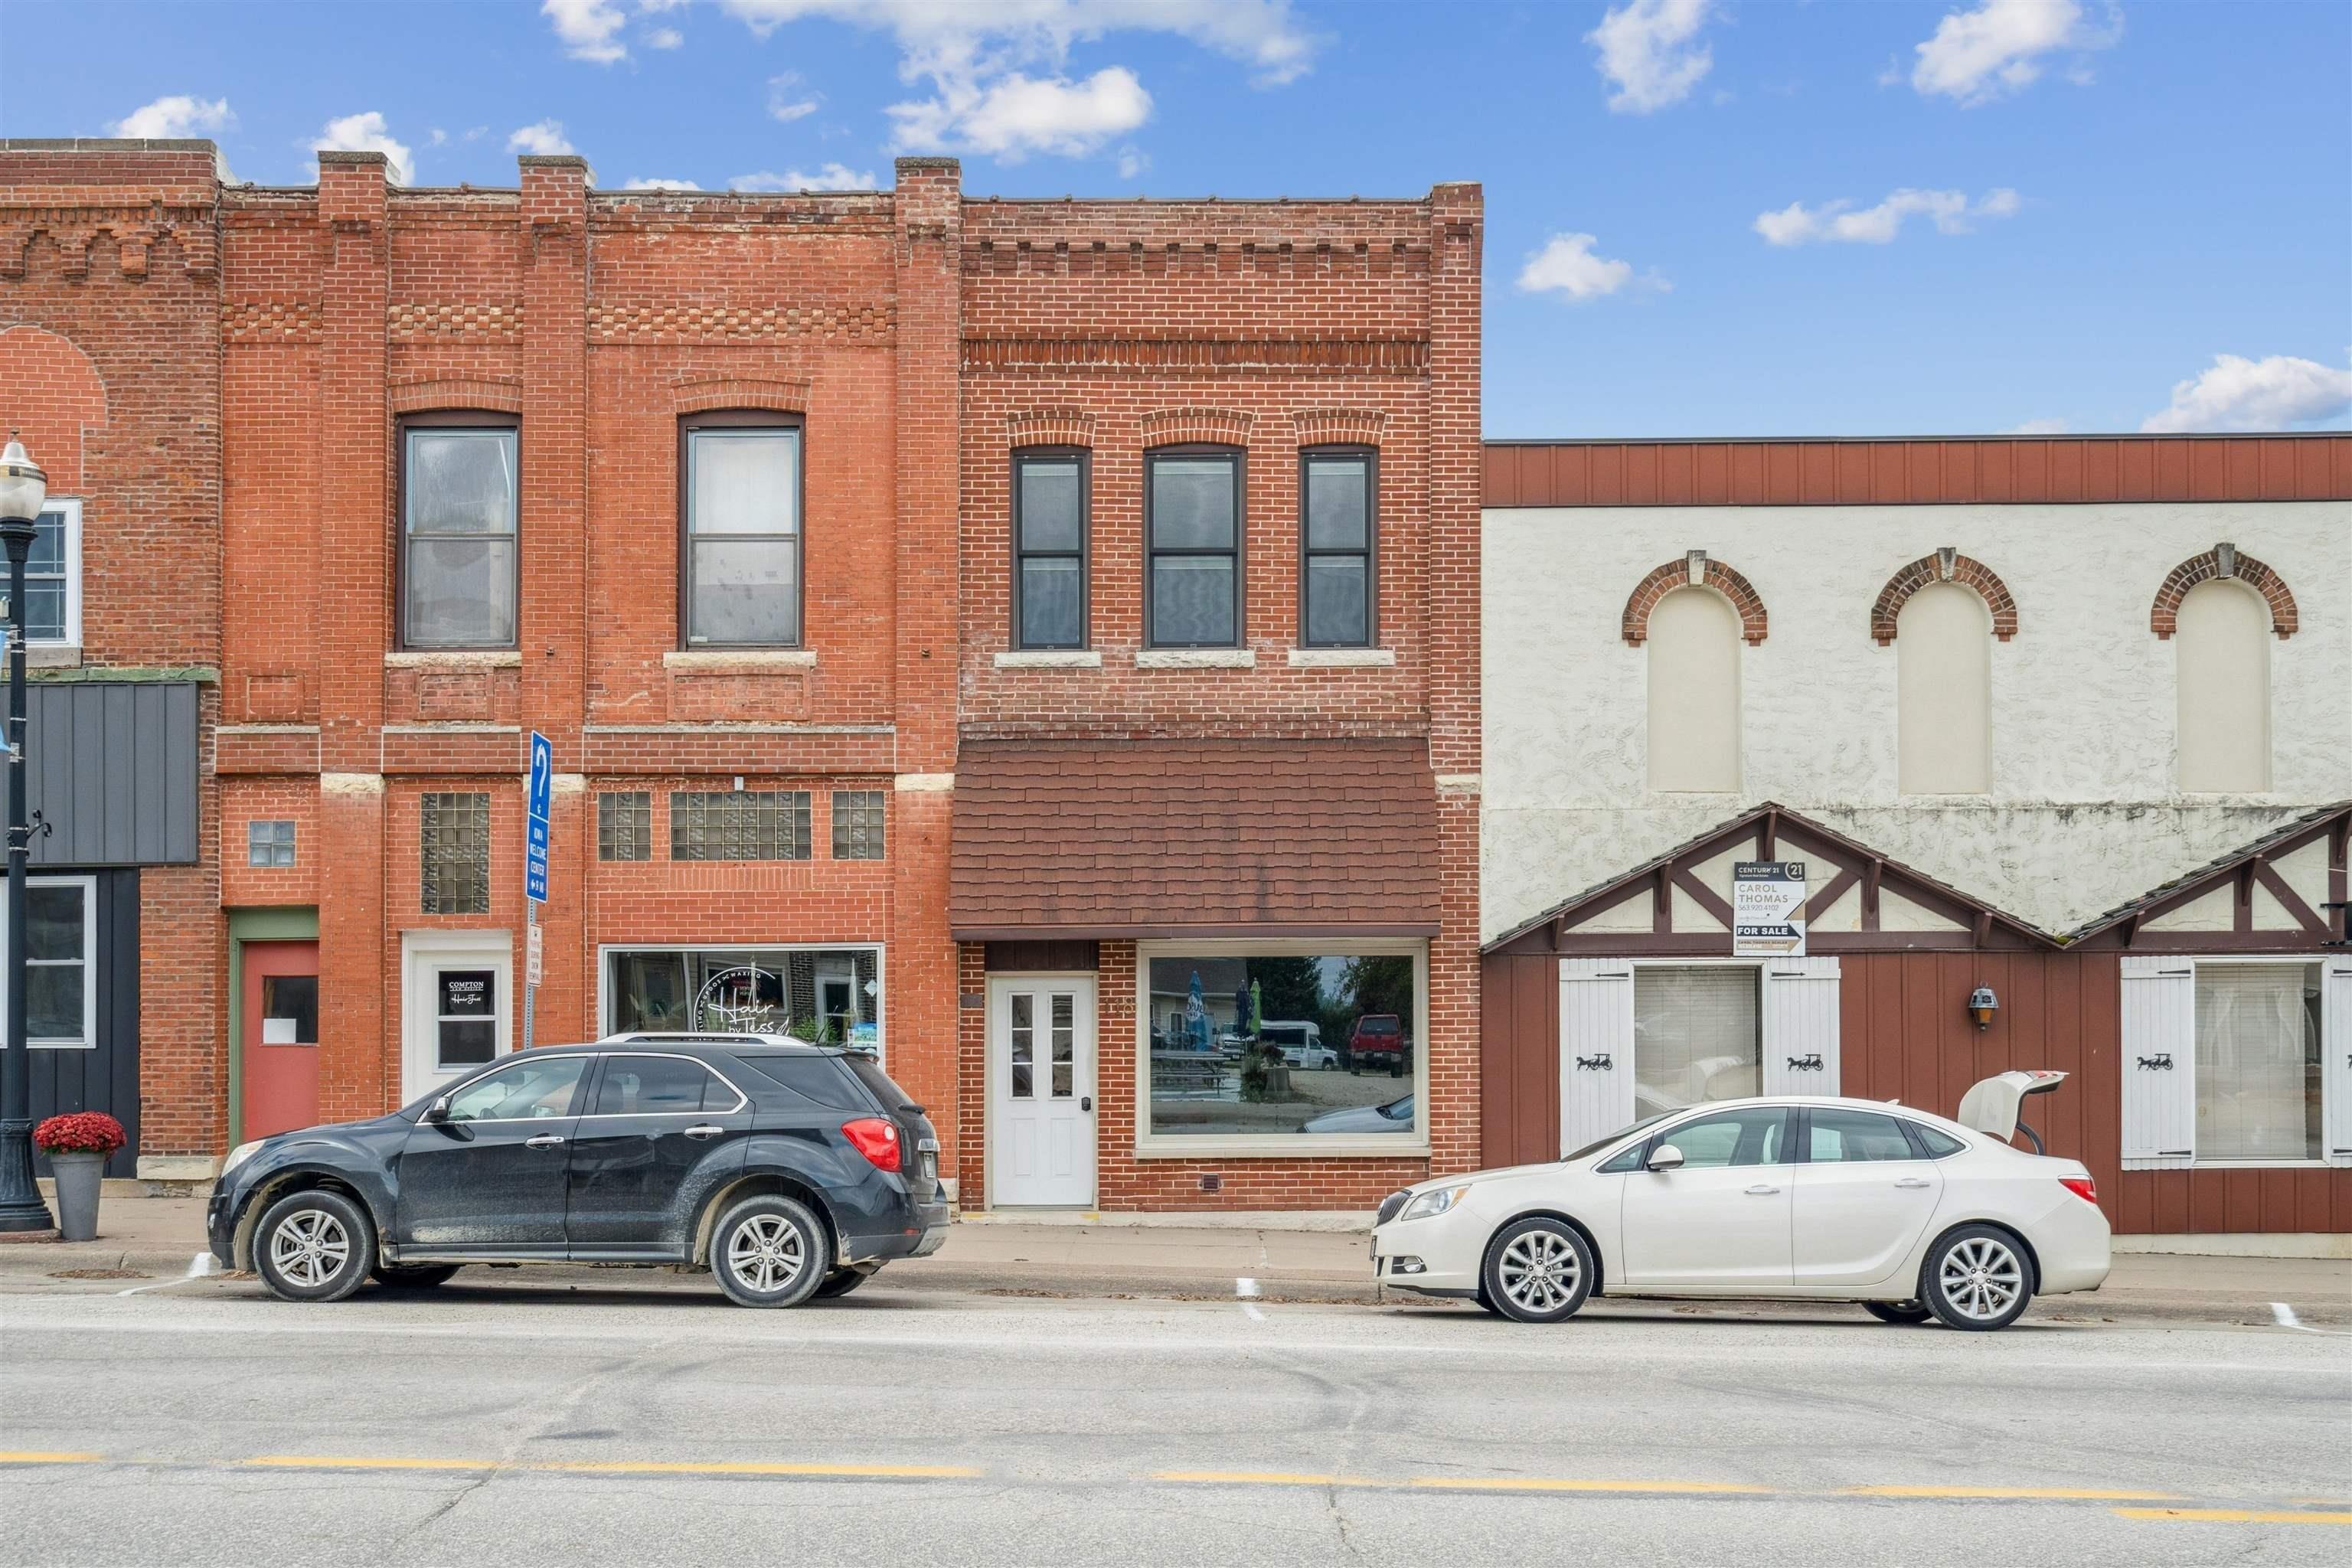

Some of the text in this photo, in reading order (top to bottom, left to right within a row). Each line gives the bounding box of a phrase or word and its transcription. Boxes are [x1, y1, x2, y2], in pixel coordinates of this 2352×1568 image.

[530, 842, 547, 861] WELCOME
[531, 862, 545, 877] CENTER
[1791, 864, 1802, 875] 21
[1739, 884, 1777, 893] CAROL
[1739, 894, 1788, 903] THOMAS
[1737, 927, 1788, 936] FOR SALE
[702, 979, 722, 1000] UPDOS
[707, 986, 775, 1025] Hair
[729, 1017, 775, 1034] Tess
